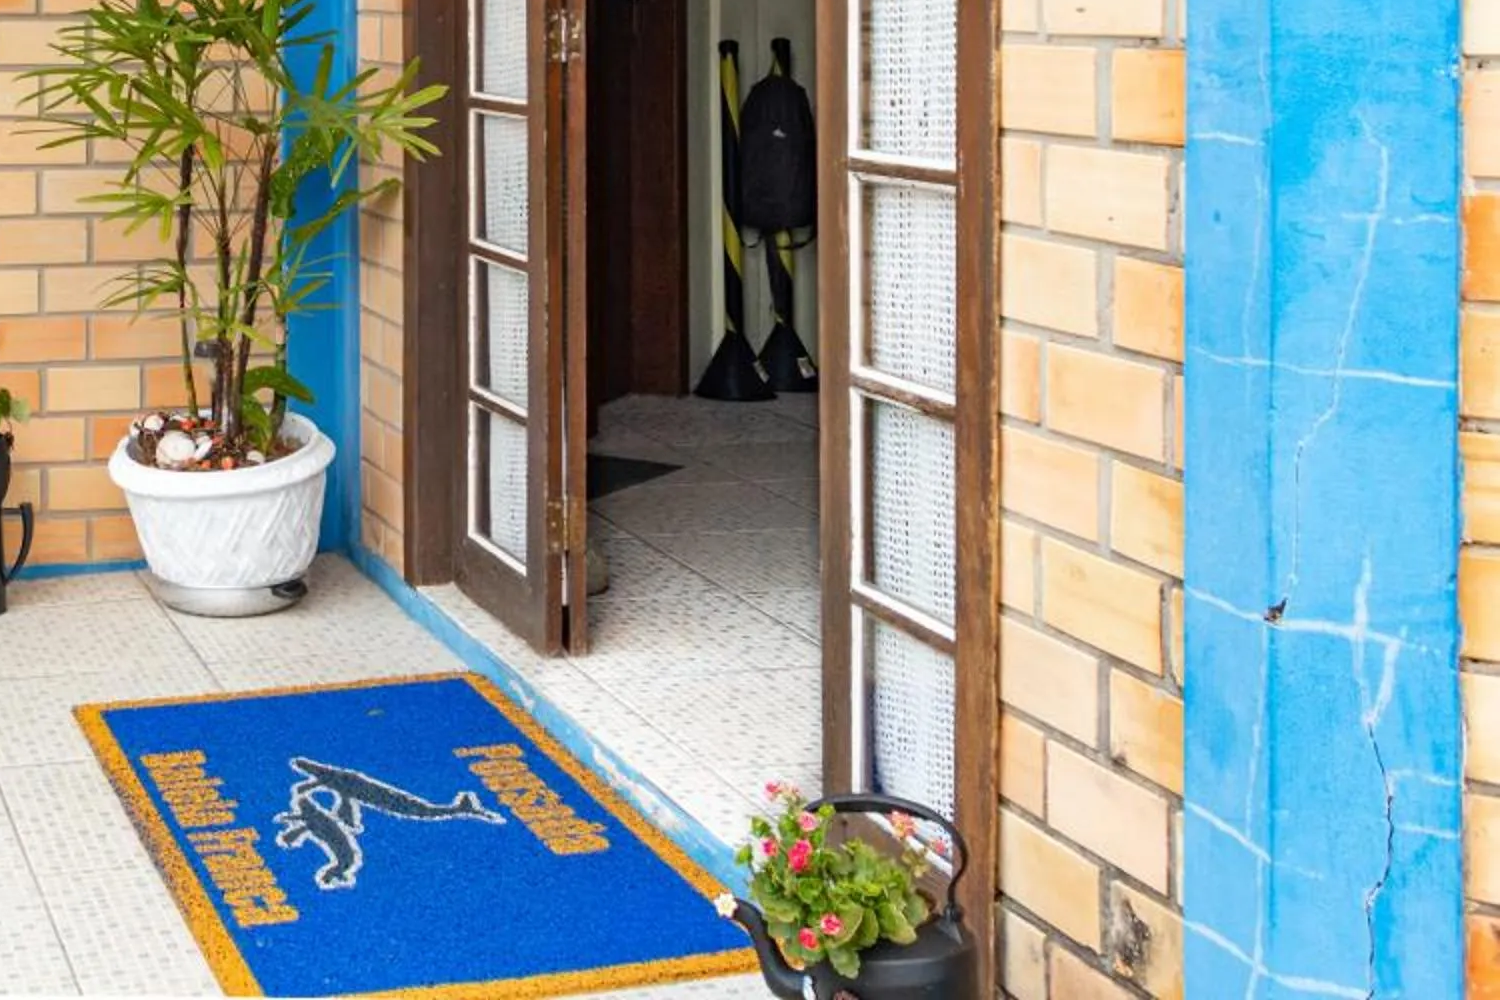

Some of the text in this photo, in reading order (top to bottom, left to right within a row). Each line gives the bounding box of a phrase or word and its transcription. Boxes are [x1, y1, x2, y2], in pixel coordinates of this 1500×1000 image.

[141, 750, 299, 928] Baleia Franca
[452, 743, 610, 856] Pousada
